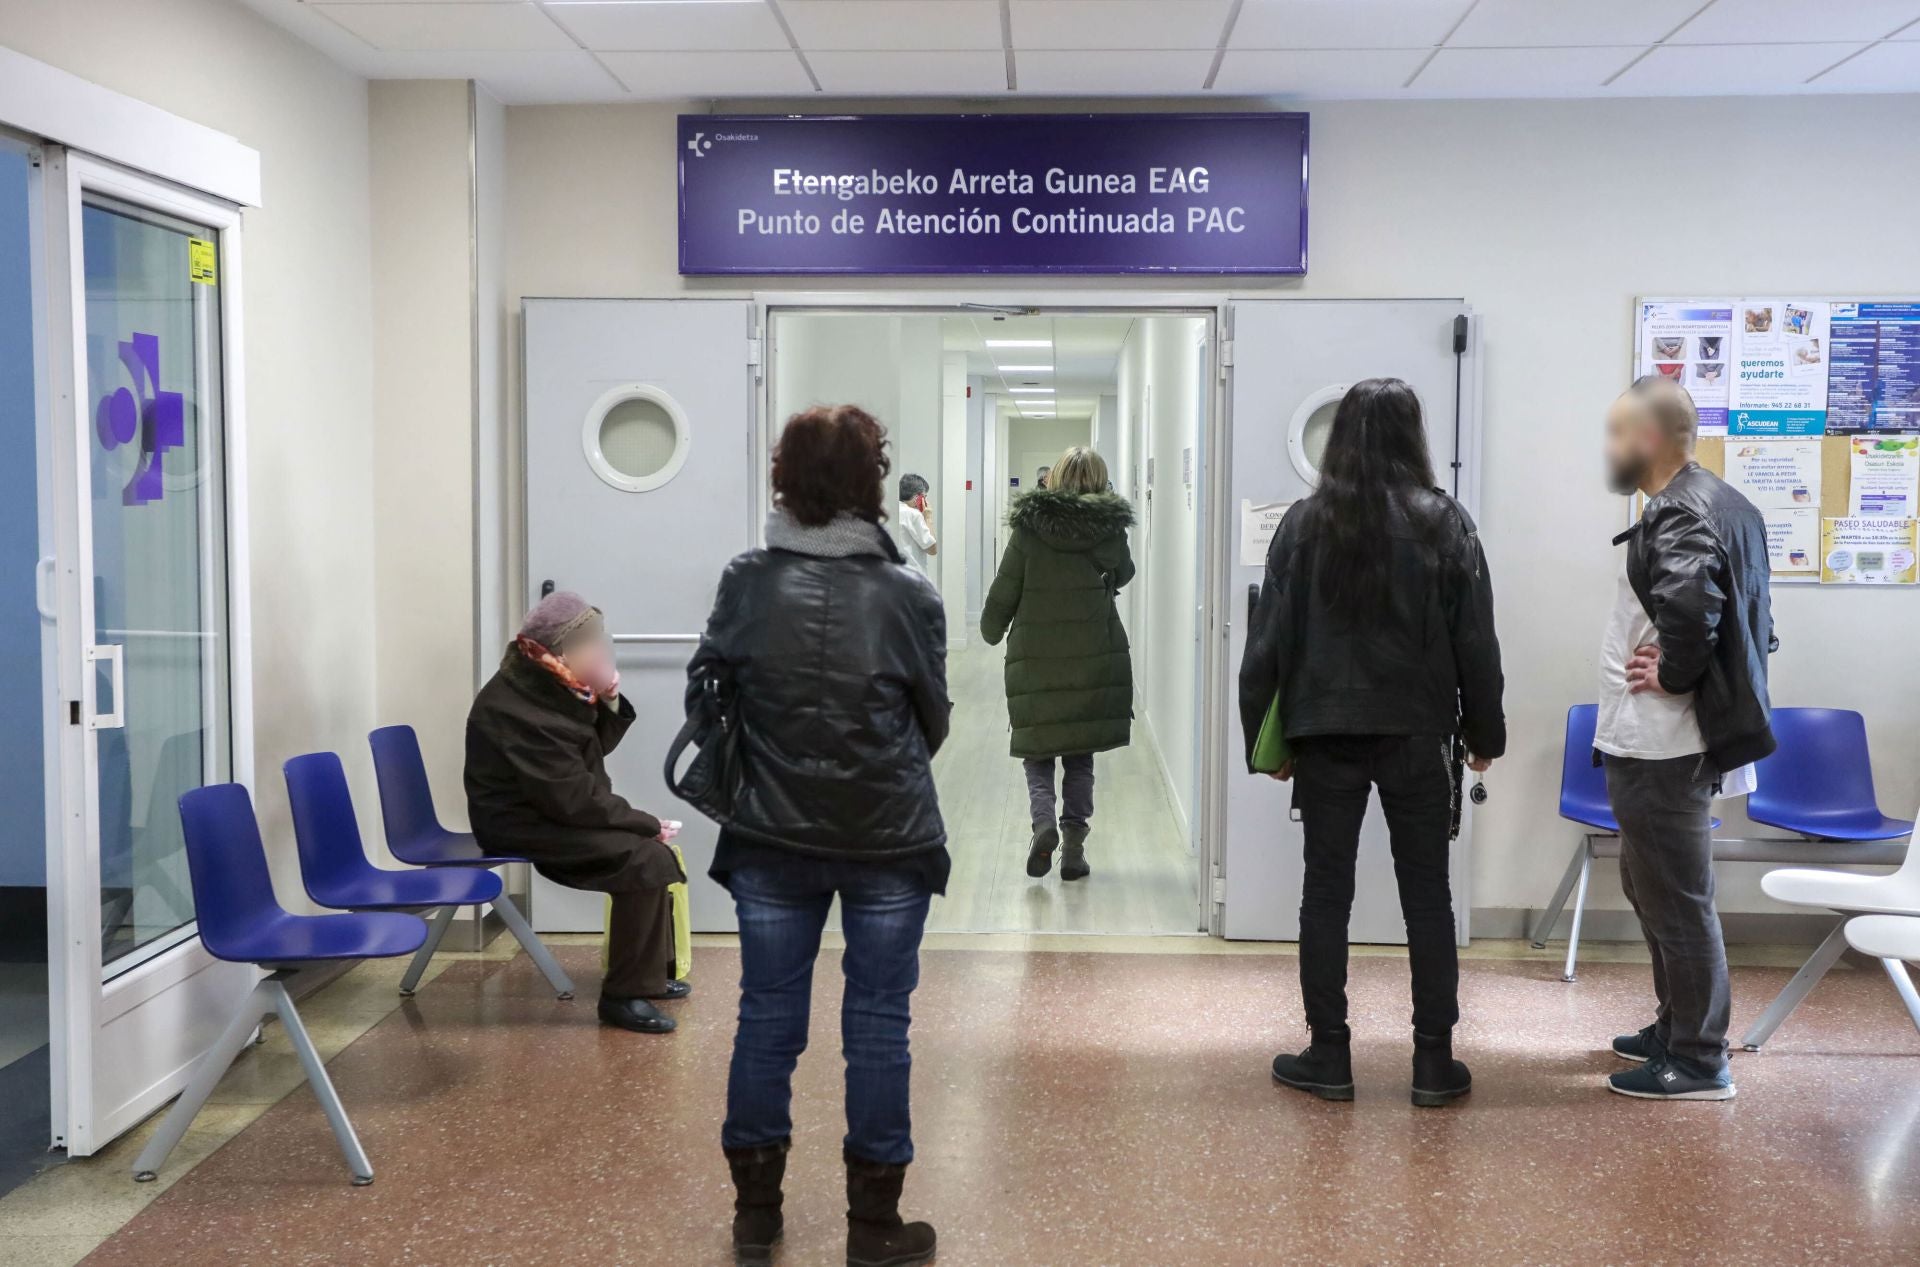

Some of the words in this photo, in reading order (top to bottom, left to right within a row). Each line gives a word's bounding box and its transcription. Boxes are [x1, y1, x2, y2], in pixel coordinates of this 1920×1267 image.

[715, 133, 759, 141] Osakidetza
[773, 168, 938, 201] Etengabeko
[948, 168, 1034, 194] Arreta
[1045, 167, 1136, 194] Gunea
[1149, 166, 1210, 194] EAG
[738, 208, 821, 235] Punto
[830, 208, 865, 235] de
[875, 207, 1001, 235] Atención
[1012, 206, 1175, 234] Continuada
[1187, 206, 1246, 233] PAC
[1740, 360, 1785, 369] queremos
[1740, 369, 1784, 381] ayudarte
[1834, 520, 1860, 528] PASEO
[1861, 520, 1909, 528] SALUDABLE
